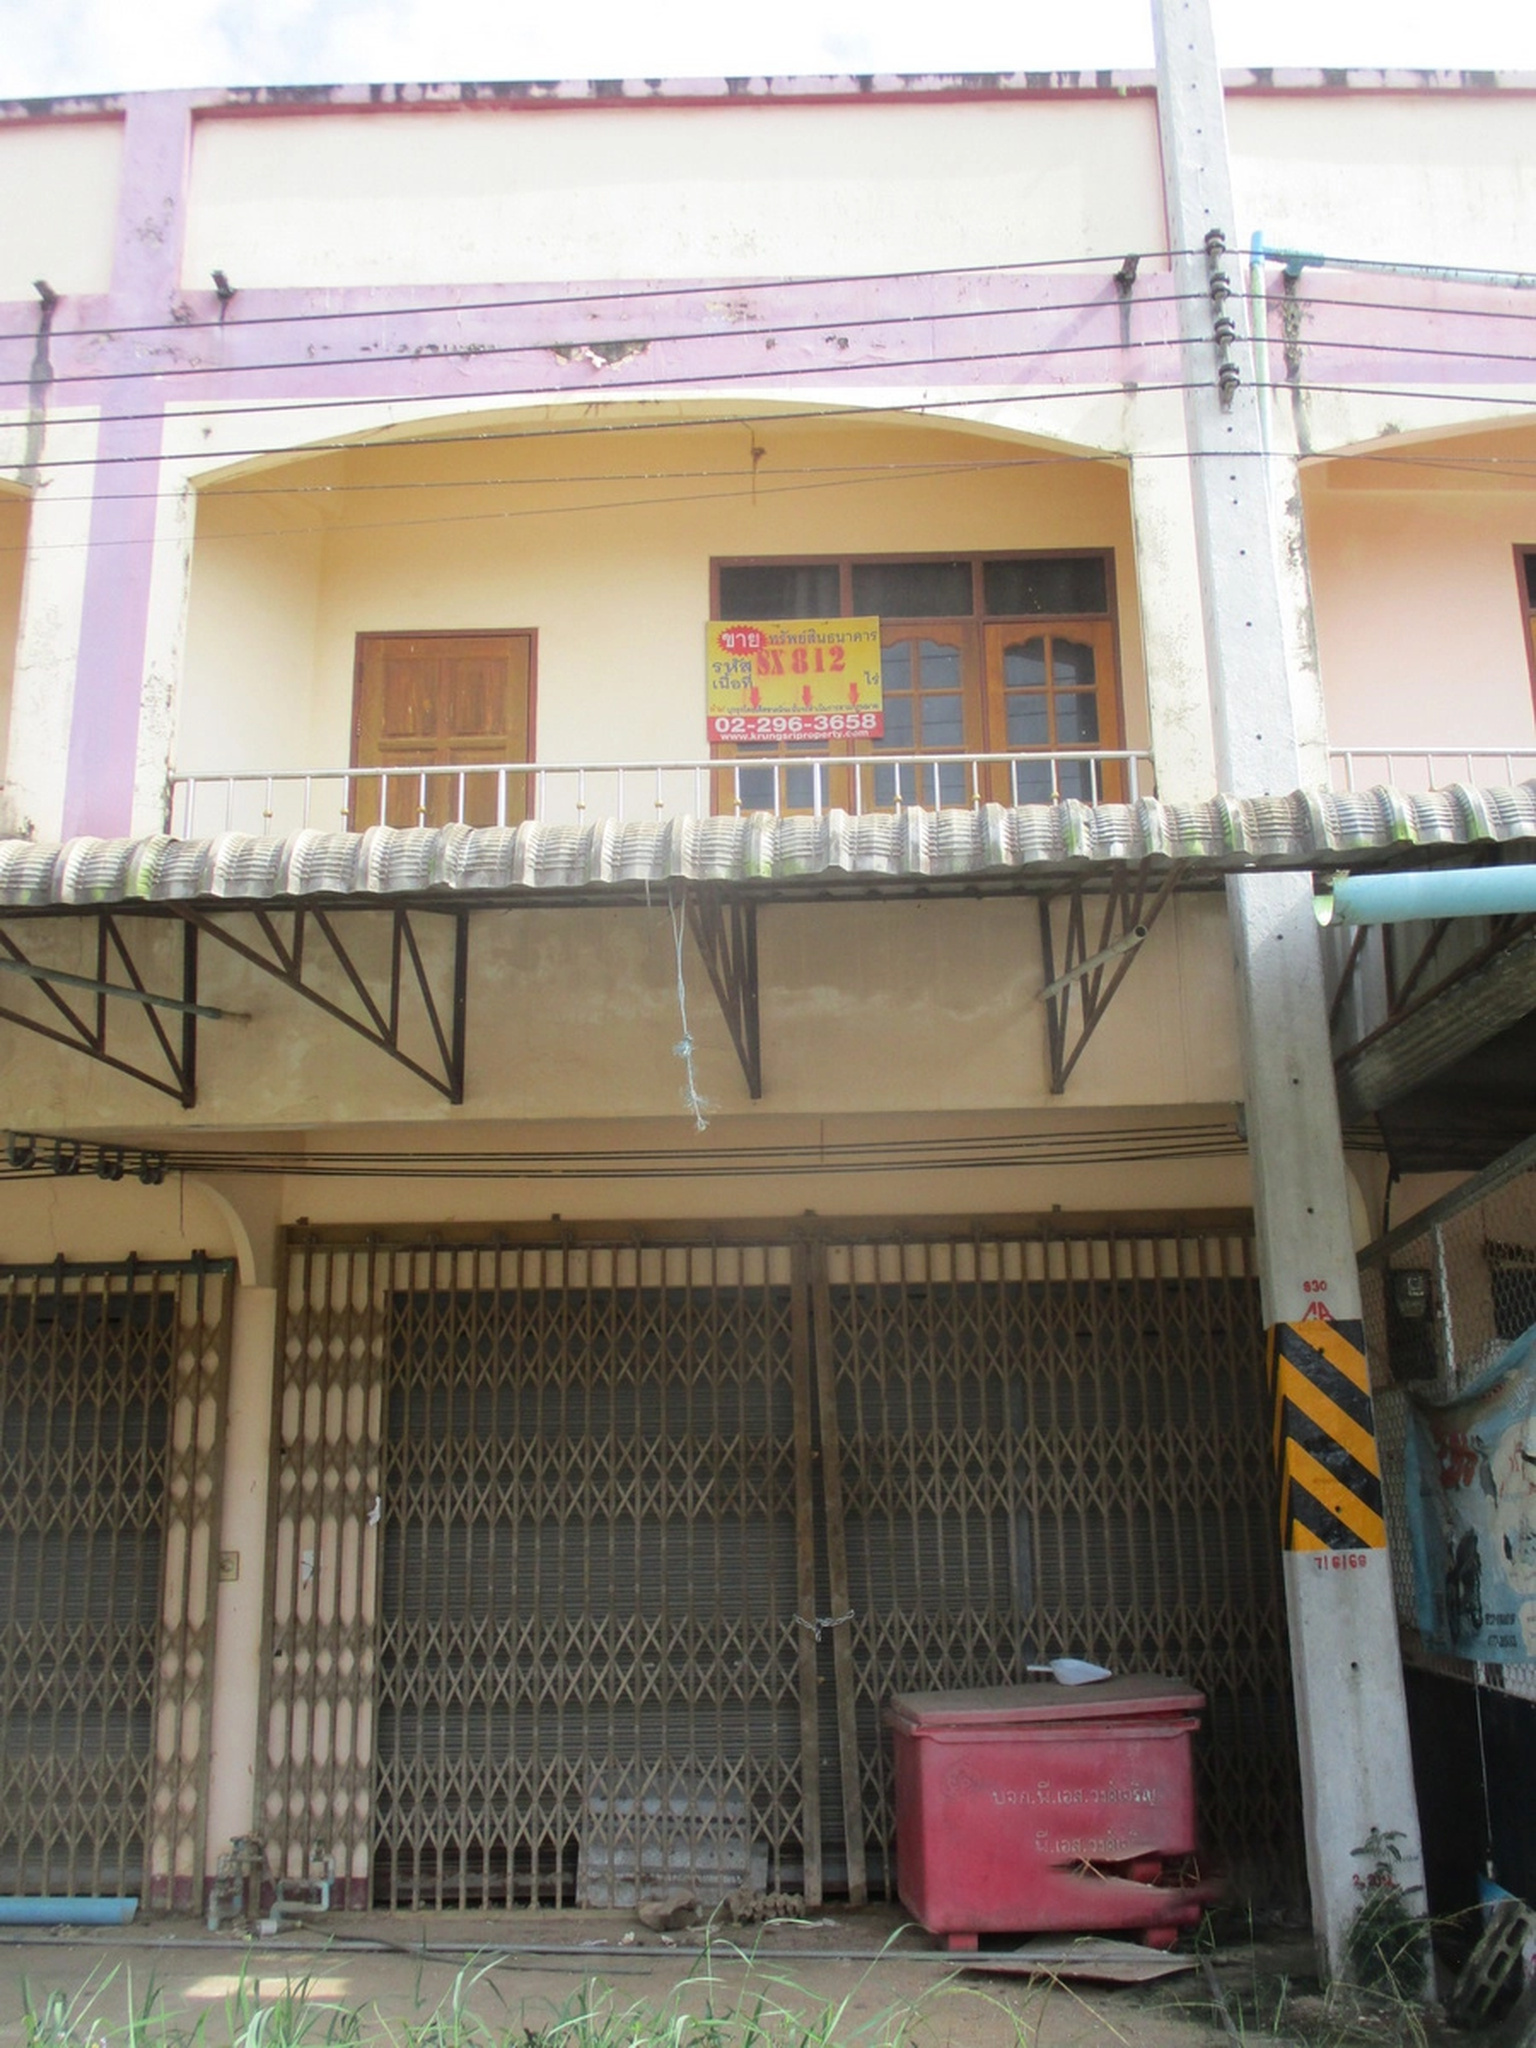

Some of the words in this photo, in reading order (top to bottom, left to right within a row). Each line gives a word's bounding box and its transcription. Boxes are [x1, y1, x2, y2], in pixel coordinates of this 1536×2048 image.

[721, 632, 761, 649] ขาย
[768, 628, 878, 645] ทรัพย์สินธนาคาร
[712, 657, 752, 675] รหัส
[714, 714, 877, 733] 02-296-3658
[719, 730, 870, 741] www.krungsriproperty.com
